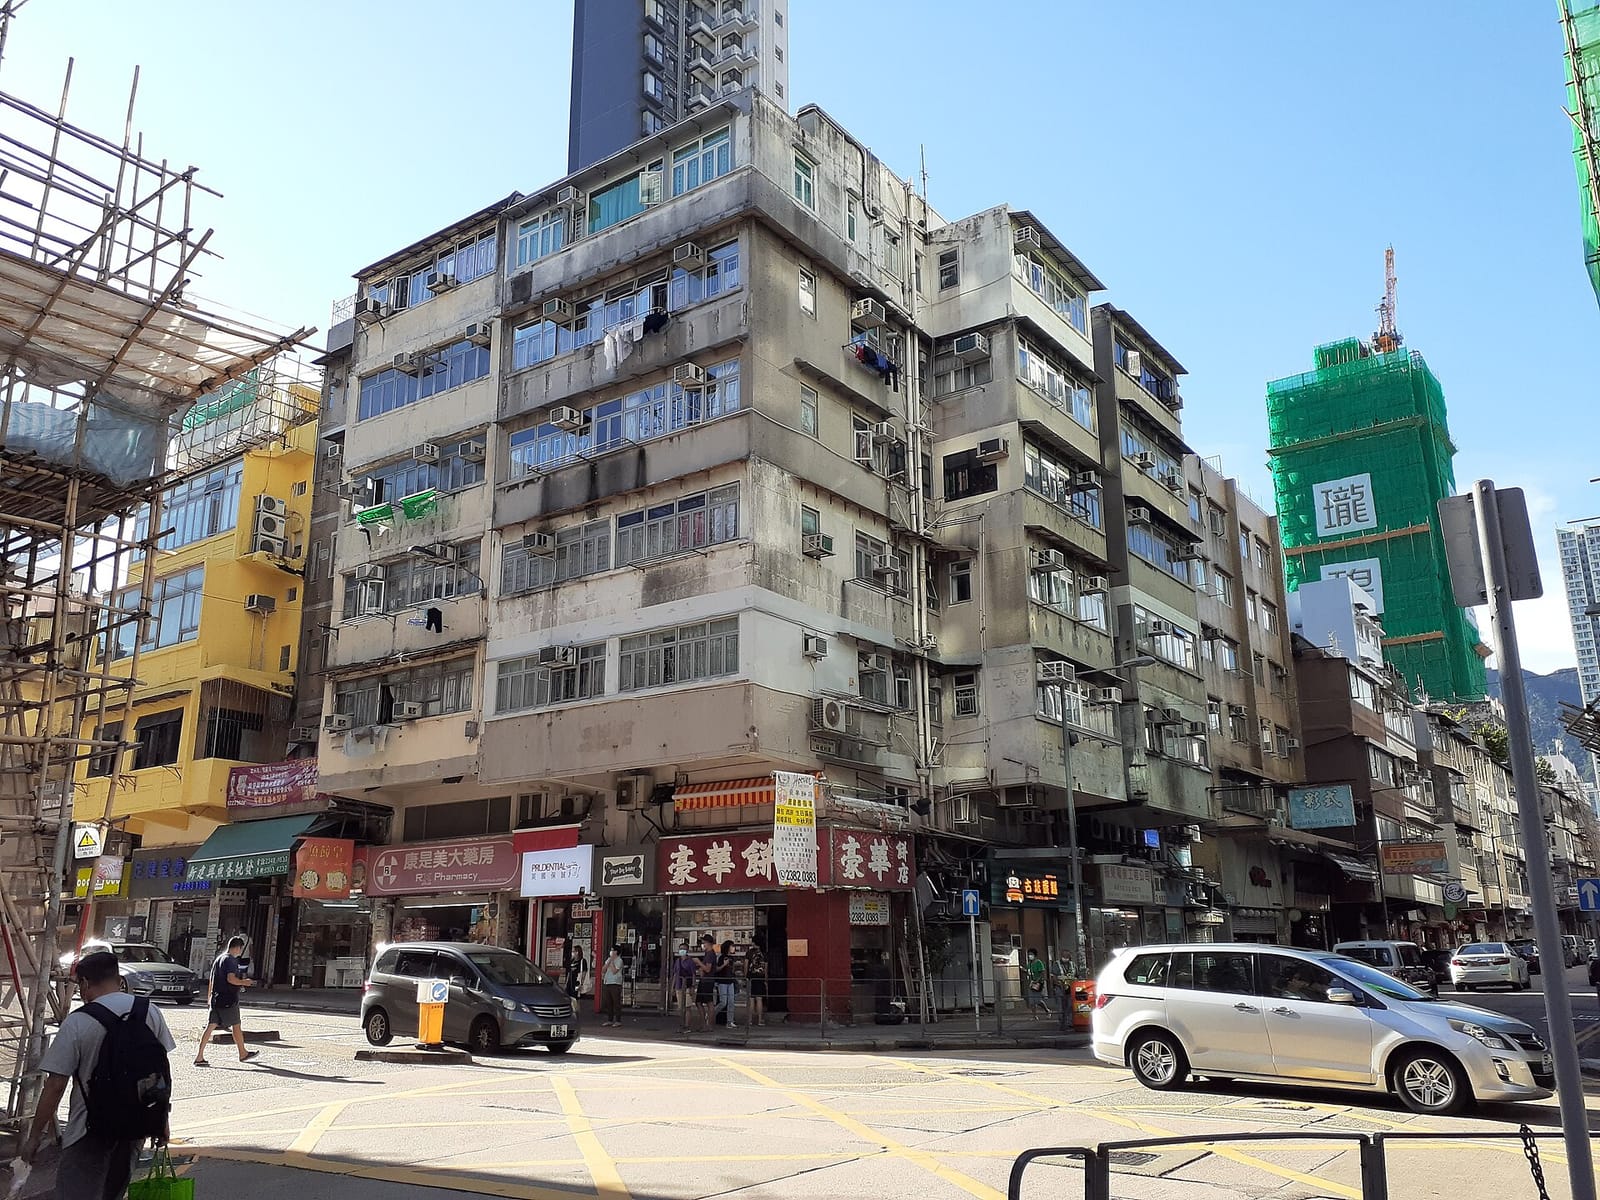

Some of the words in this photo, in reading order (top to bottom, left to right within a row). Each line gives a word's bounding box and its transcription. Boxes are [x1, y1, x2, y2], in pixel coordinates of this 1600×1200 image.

[1320, 483, 1370, 530] 瓏
[403, 845, 495, 870] 康是美大藥房
[531, 862, 567, 873] PRUDENTIAL
[667, 839, 820, 886] 豪華餅
[840, 835, 893, 882] 豪華
[896, 840, 909, 885] 餅店
[434, 871, 479, 883] Pharmacy
[785, 869, 801, 882] 2382
[802, 870, 816, 883] 0383
[851, 911, 865, 922] 2382
[865, 912, 879, 922] 0383
